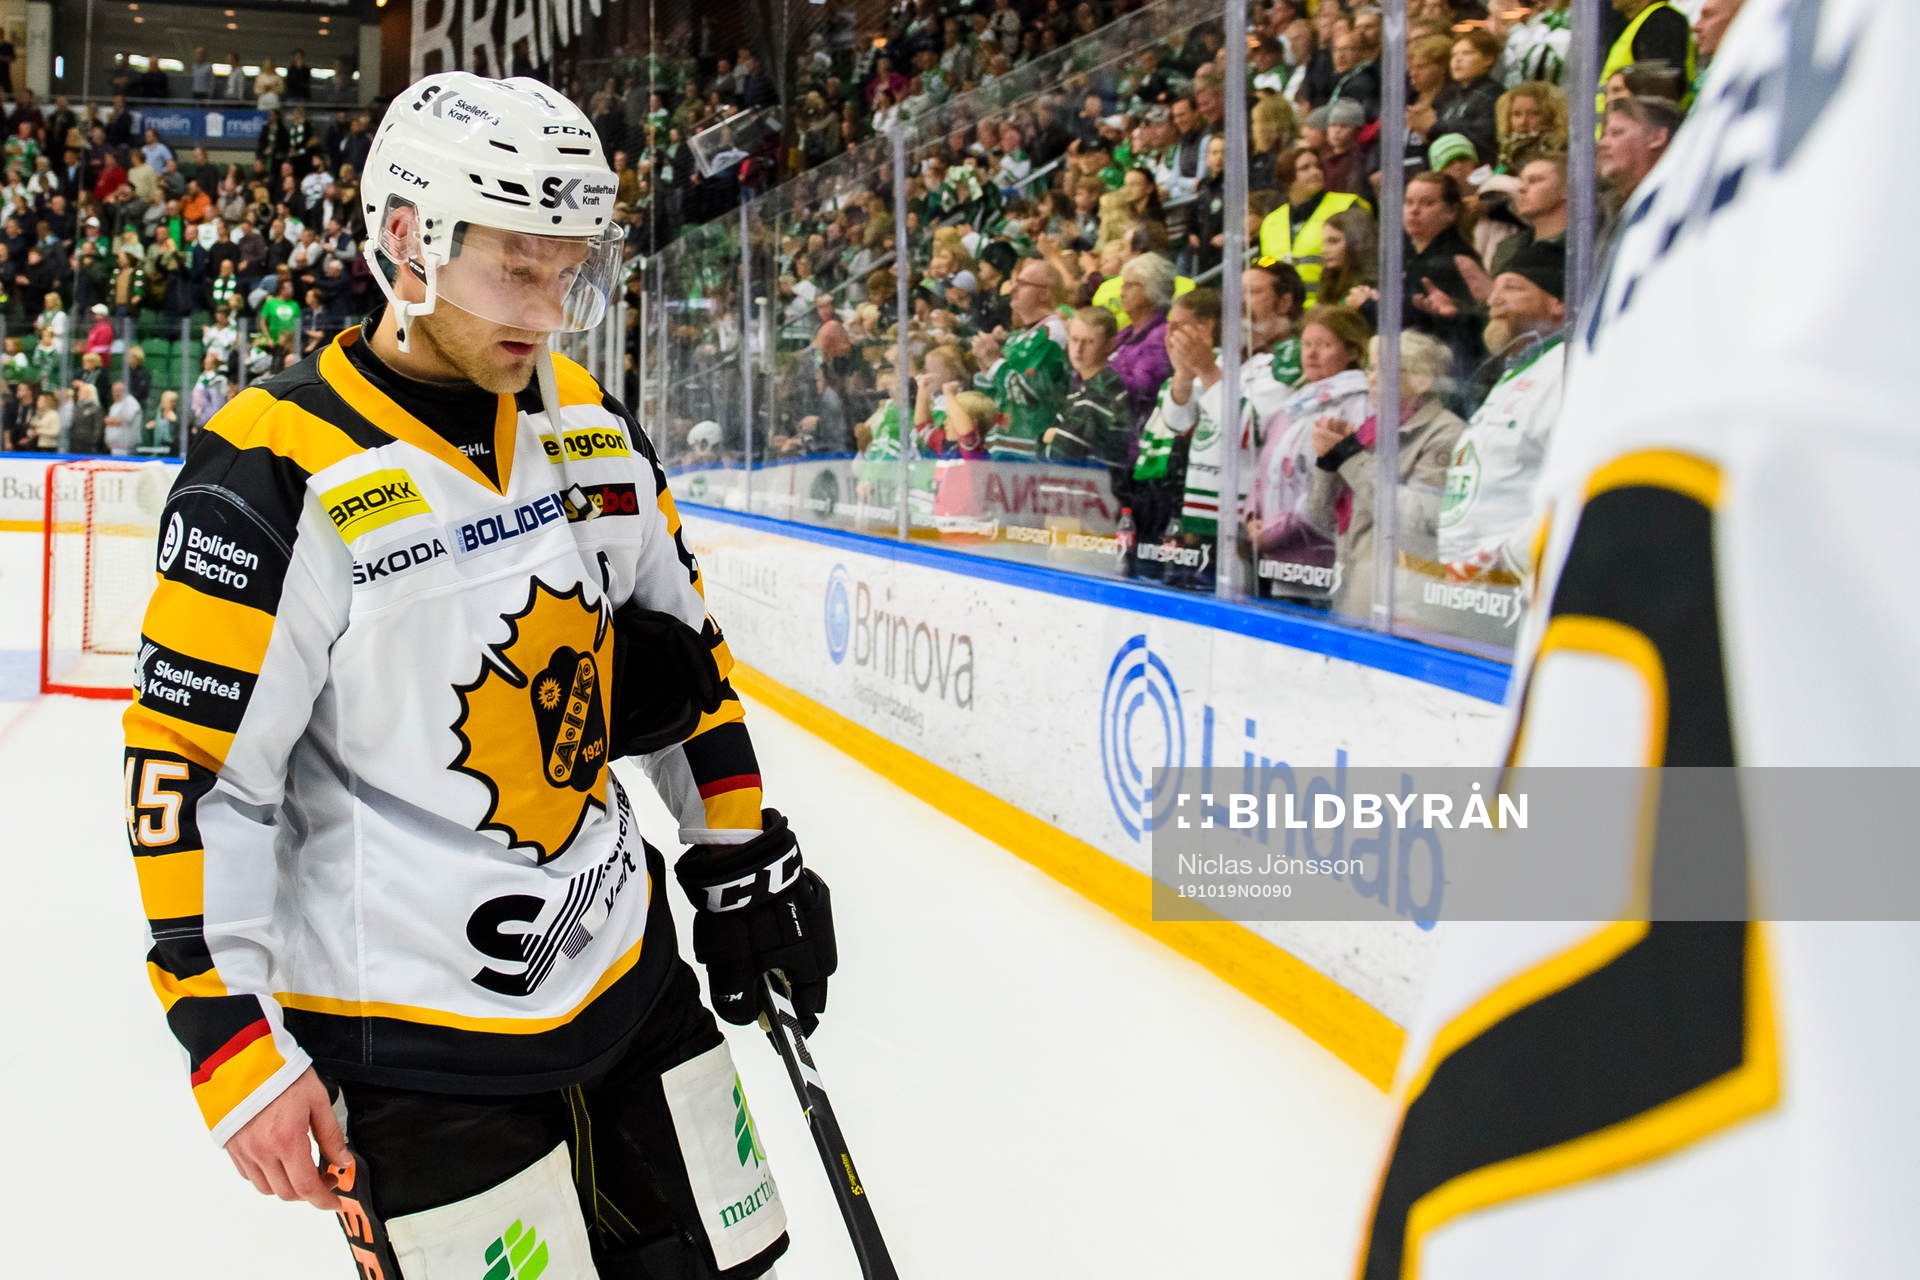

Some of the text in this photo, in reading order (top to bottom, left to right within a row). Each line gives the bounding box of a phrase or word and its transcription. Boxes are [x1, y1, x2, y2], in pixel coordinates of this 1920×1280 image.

[447, 109, 472, 125] Kraft
[542, 125, 592, 139] CCM
[388, 162, 431, 190] CCM
[582, 195, 600, 206] Kraft
[459, 442, 491, 457] SHL
[543, 433, 629, 457] engcon
[328, 481, 418, 528] BROKK
[461, 492, 565, 553] BOLIDEN
[187, 527, 259, 570] Boliden
[184, 550, 248, 590] Electro
[855, 581, 974, 712] Brinova
[148, 678, 192, 706] Kraft
[154, 659, 241, 701] Skellefteå
[582, 737, 605, 763] 1921
[1202, 704, 1445, 931] Lindab
